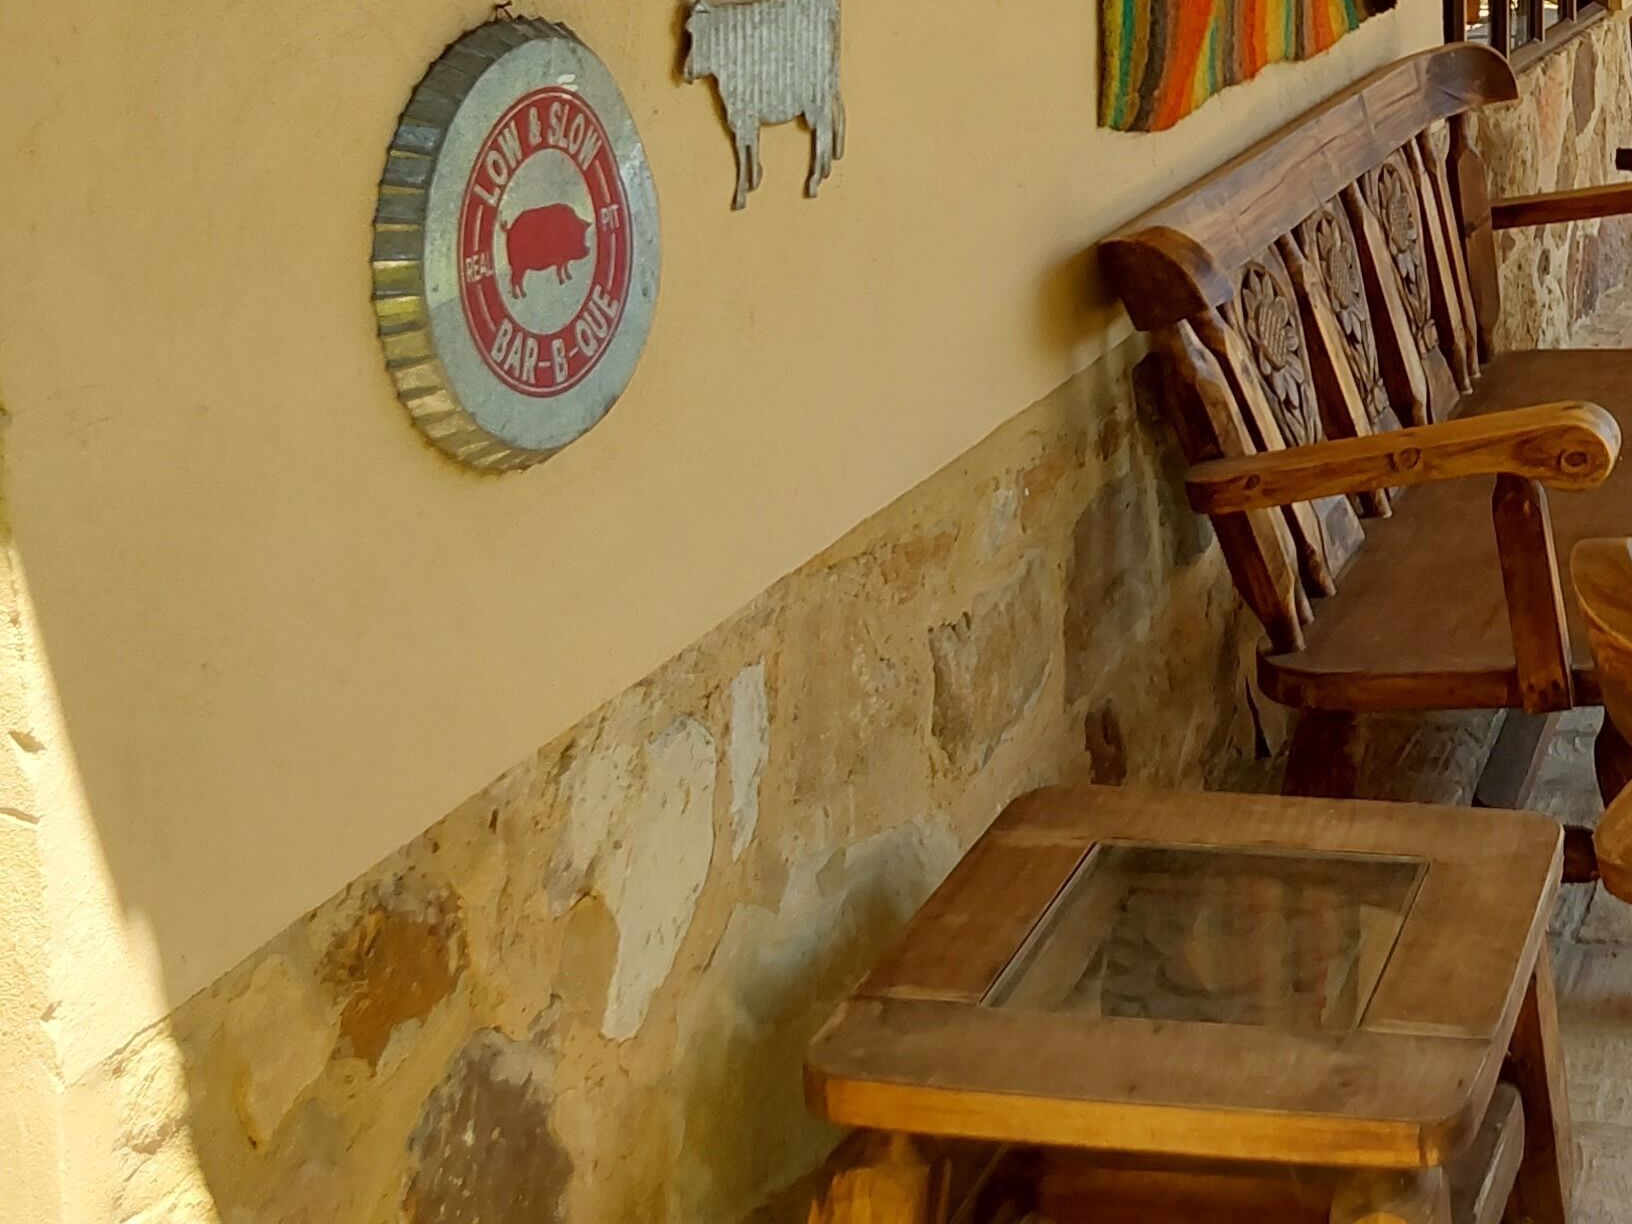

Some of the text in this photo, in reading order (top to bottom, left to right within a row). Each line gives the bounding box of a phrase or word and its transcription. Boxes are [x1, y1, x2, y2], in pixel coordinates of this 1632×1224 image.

[474, 102, 602, 207] LOW & SLOW
[601, 204, 621, 232] PIT
[465, 253, 494, 283] REAL
[490, 285, 620, 383] BAR-B-QUE
